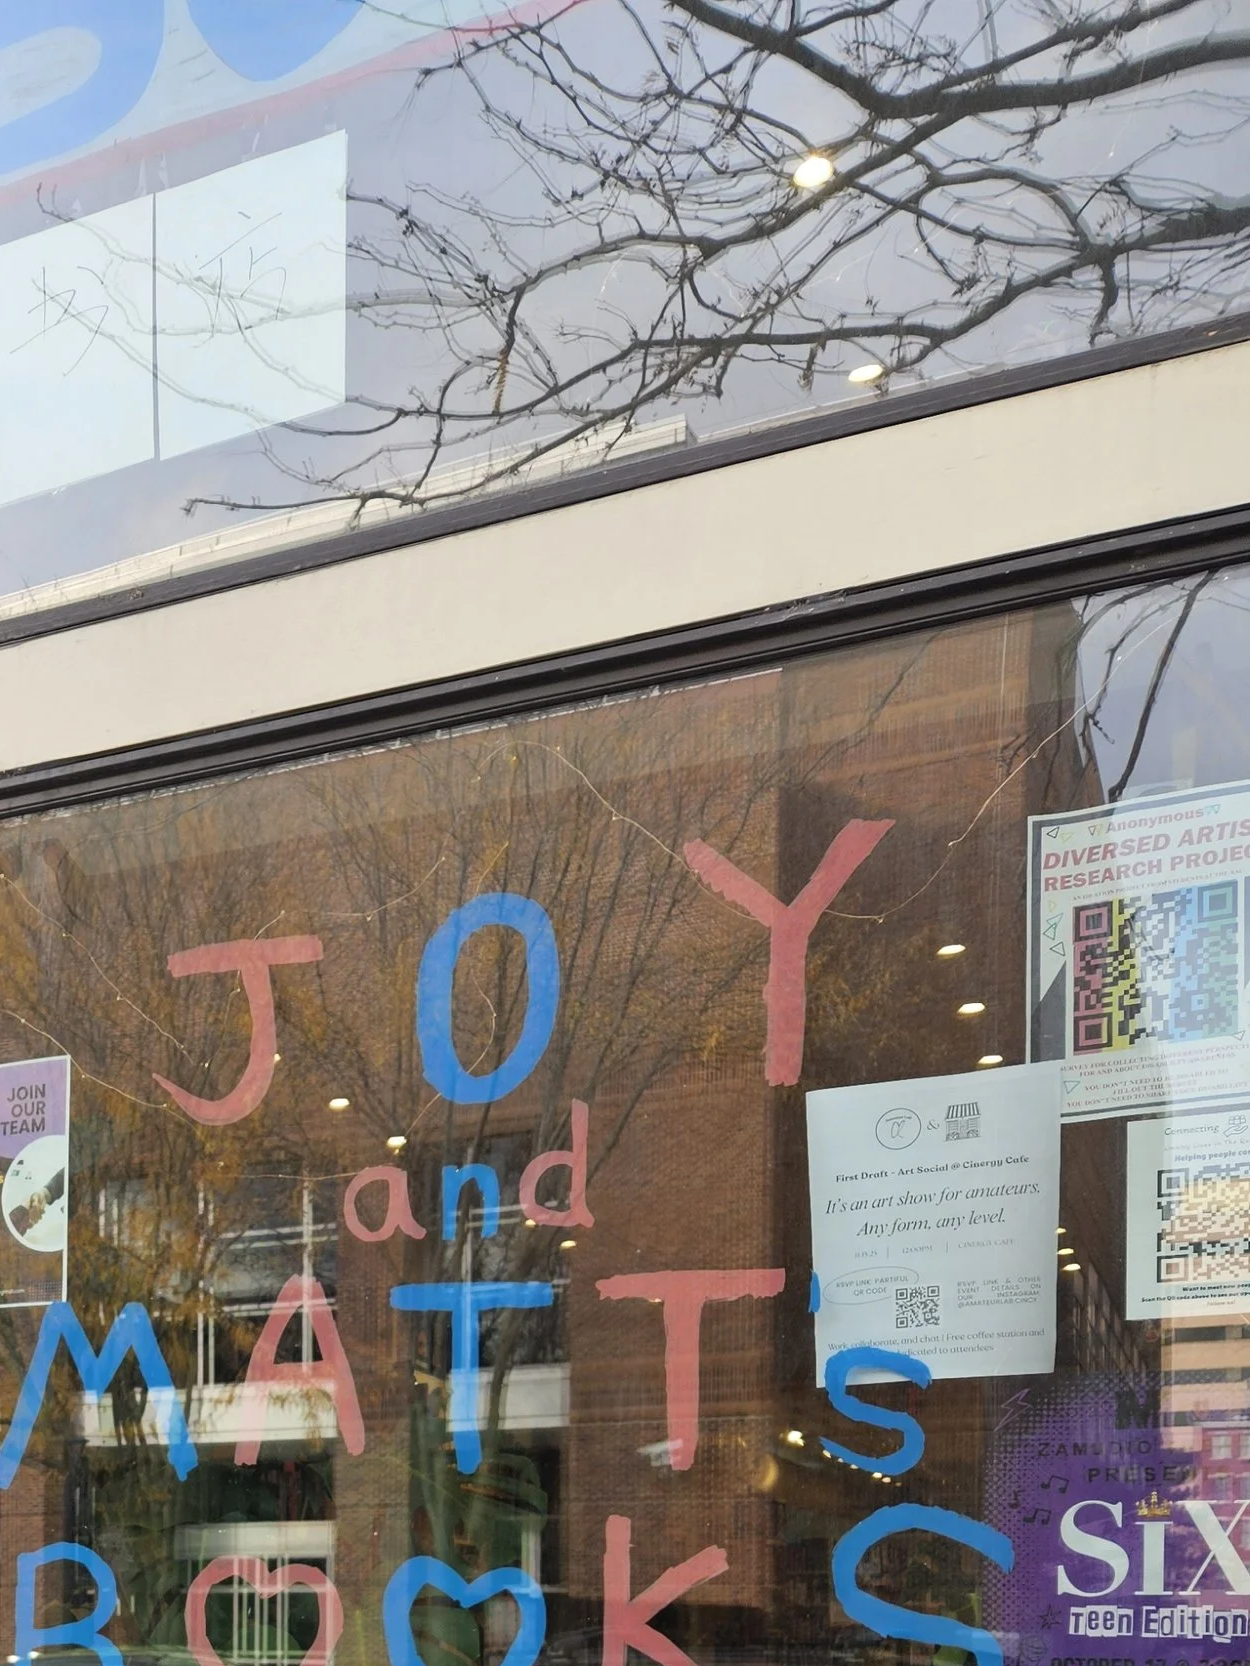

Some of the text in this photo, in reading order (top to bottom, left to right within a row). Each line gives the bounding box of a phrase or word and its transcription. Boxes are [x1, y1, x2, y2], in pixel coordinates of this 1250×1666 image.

[1106, 806, 1204, 833] Anonymous
[1043, 833, 1171, 870] DIVERSED
[1044, 858, 1163, 892] RESEARCH
[153, 817, 897, 1127] JOY
[1115, 1065, 1140, 1073] ABOUT
[7, 1083, 46, 1102] JOIN
[1102, 1081, 1126, 1089] DON'T
[1129, 1078, 1150, 1086] NEED
[11, 1101, 46, 1118] OUR
[1085, 1098, 1109, 1106] DON'T
[1112, 1095, 1133, 1103] NEED
[0, 1118, 46, 1136] TEAM
[1165, 1125, 1219, 1135] Connecting
[1175, 1150, 1237, 1162] Helping people
[344, 1099, 594, 1243] and
[836, 1155, 1029, 1183] First Draft Art Social @ Cinergy Cafe
[825, 1182, 1041, 1215] It's an art show for amateurs.
[857, 1208, 1006, 1238] Any form, any level.
[836, 1280, 854, 1288] RSVP
[866, 1287, 887, 1295] CODE
[901, 1328, 1045, 1345] and chat Free coffee station and
[938, 1343, 994, 1354] to attendees
[1069, 1606, 1249, 1639] Teen Edition
